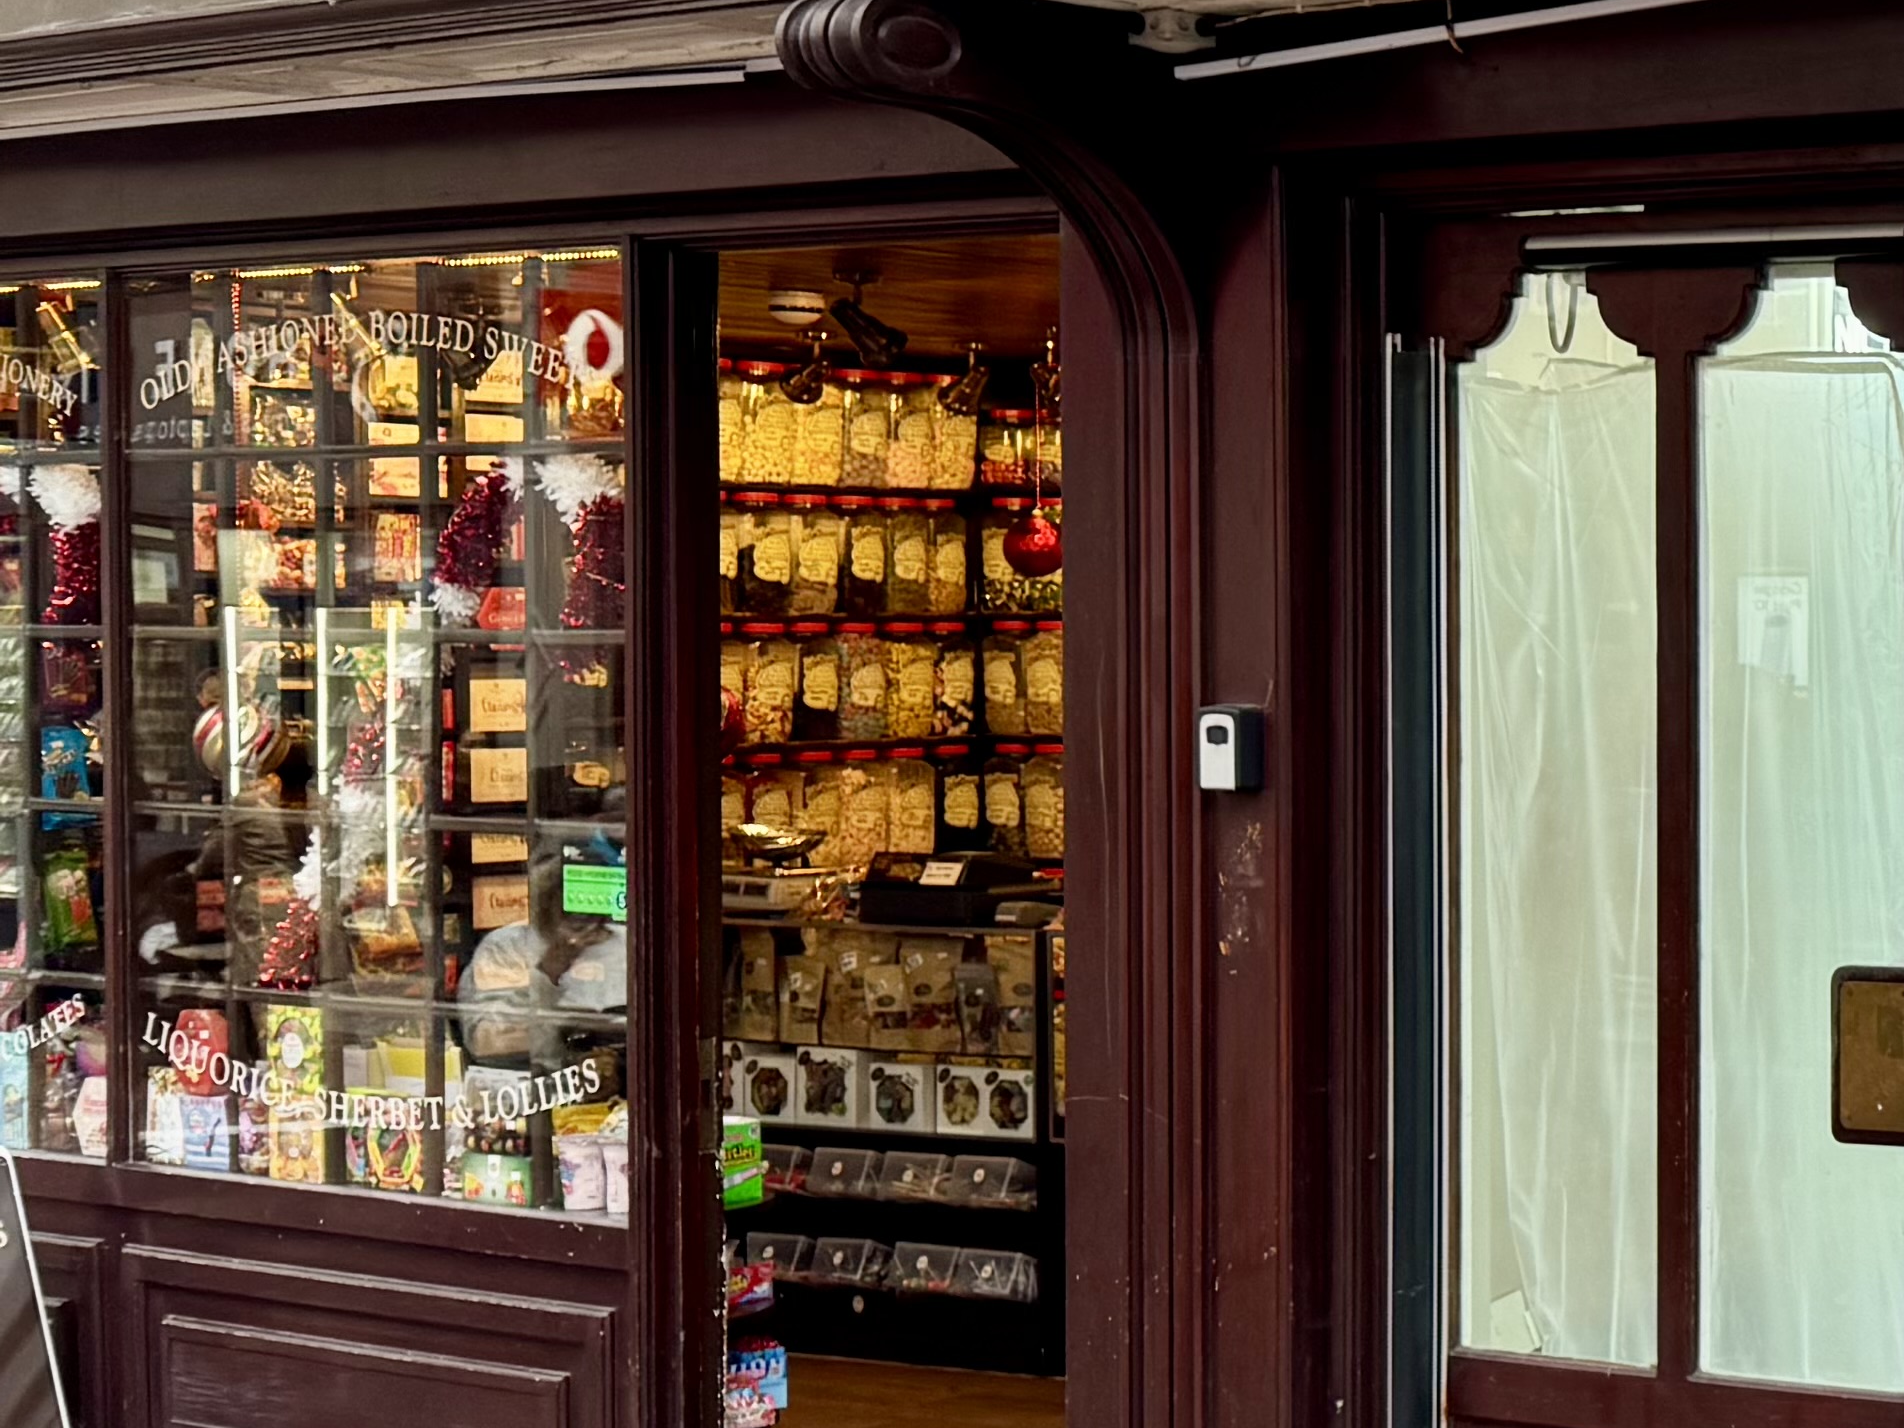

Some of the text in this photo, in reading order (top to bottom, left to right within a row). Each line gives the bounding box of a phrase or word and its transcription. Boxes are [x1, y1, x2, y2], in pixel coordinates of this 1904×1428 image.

[140, 357, 193, 410] OLD
[369, 310, 474, 353] BOILED
[314, 1087, 443, 1131] SHERBET
[451, 1094, 475, 1129] &
[480, 1057, 602, 1122] LOLLIES
